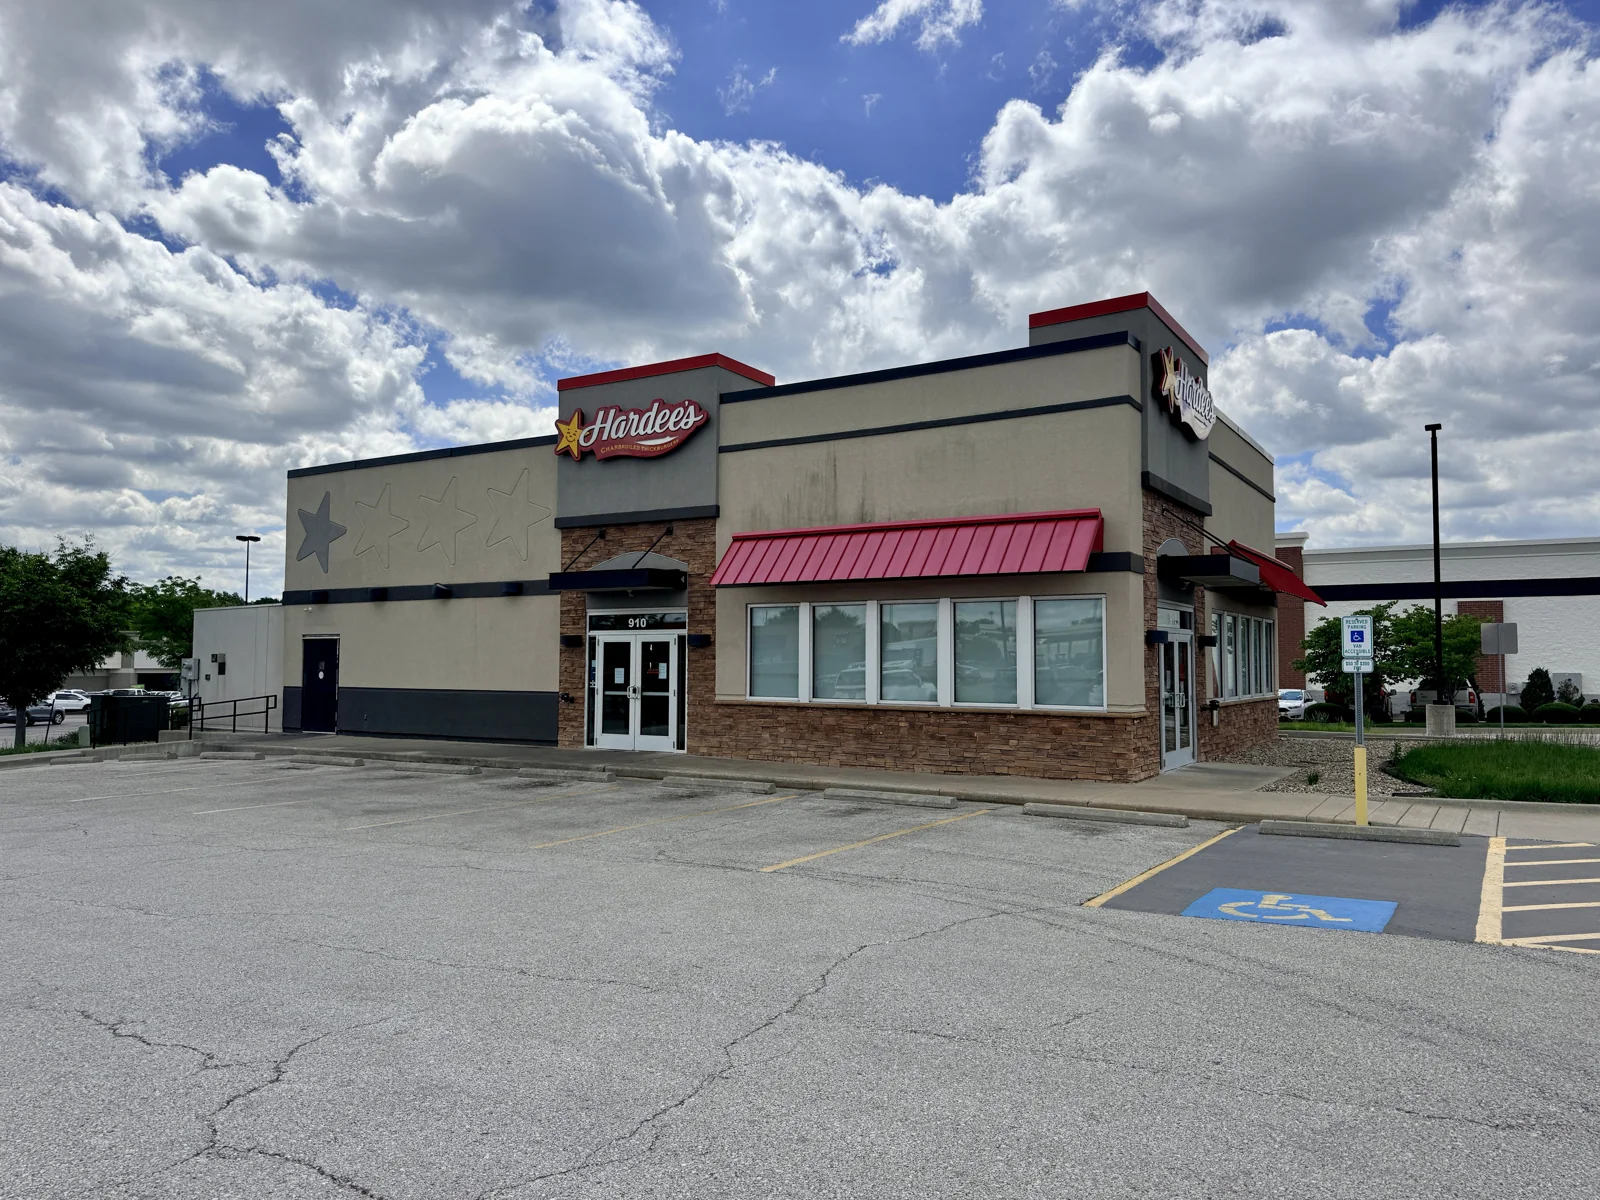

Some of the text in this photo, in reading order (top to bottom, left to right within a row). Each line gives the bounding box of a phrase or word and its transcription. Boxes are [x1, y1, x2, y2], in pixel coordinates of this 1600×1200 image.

[579, 401, 703, 447] Hardee's
[600, 444, 640, 454] CHARBROILED
[628, 618, 646, 628] 910
